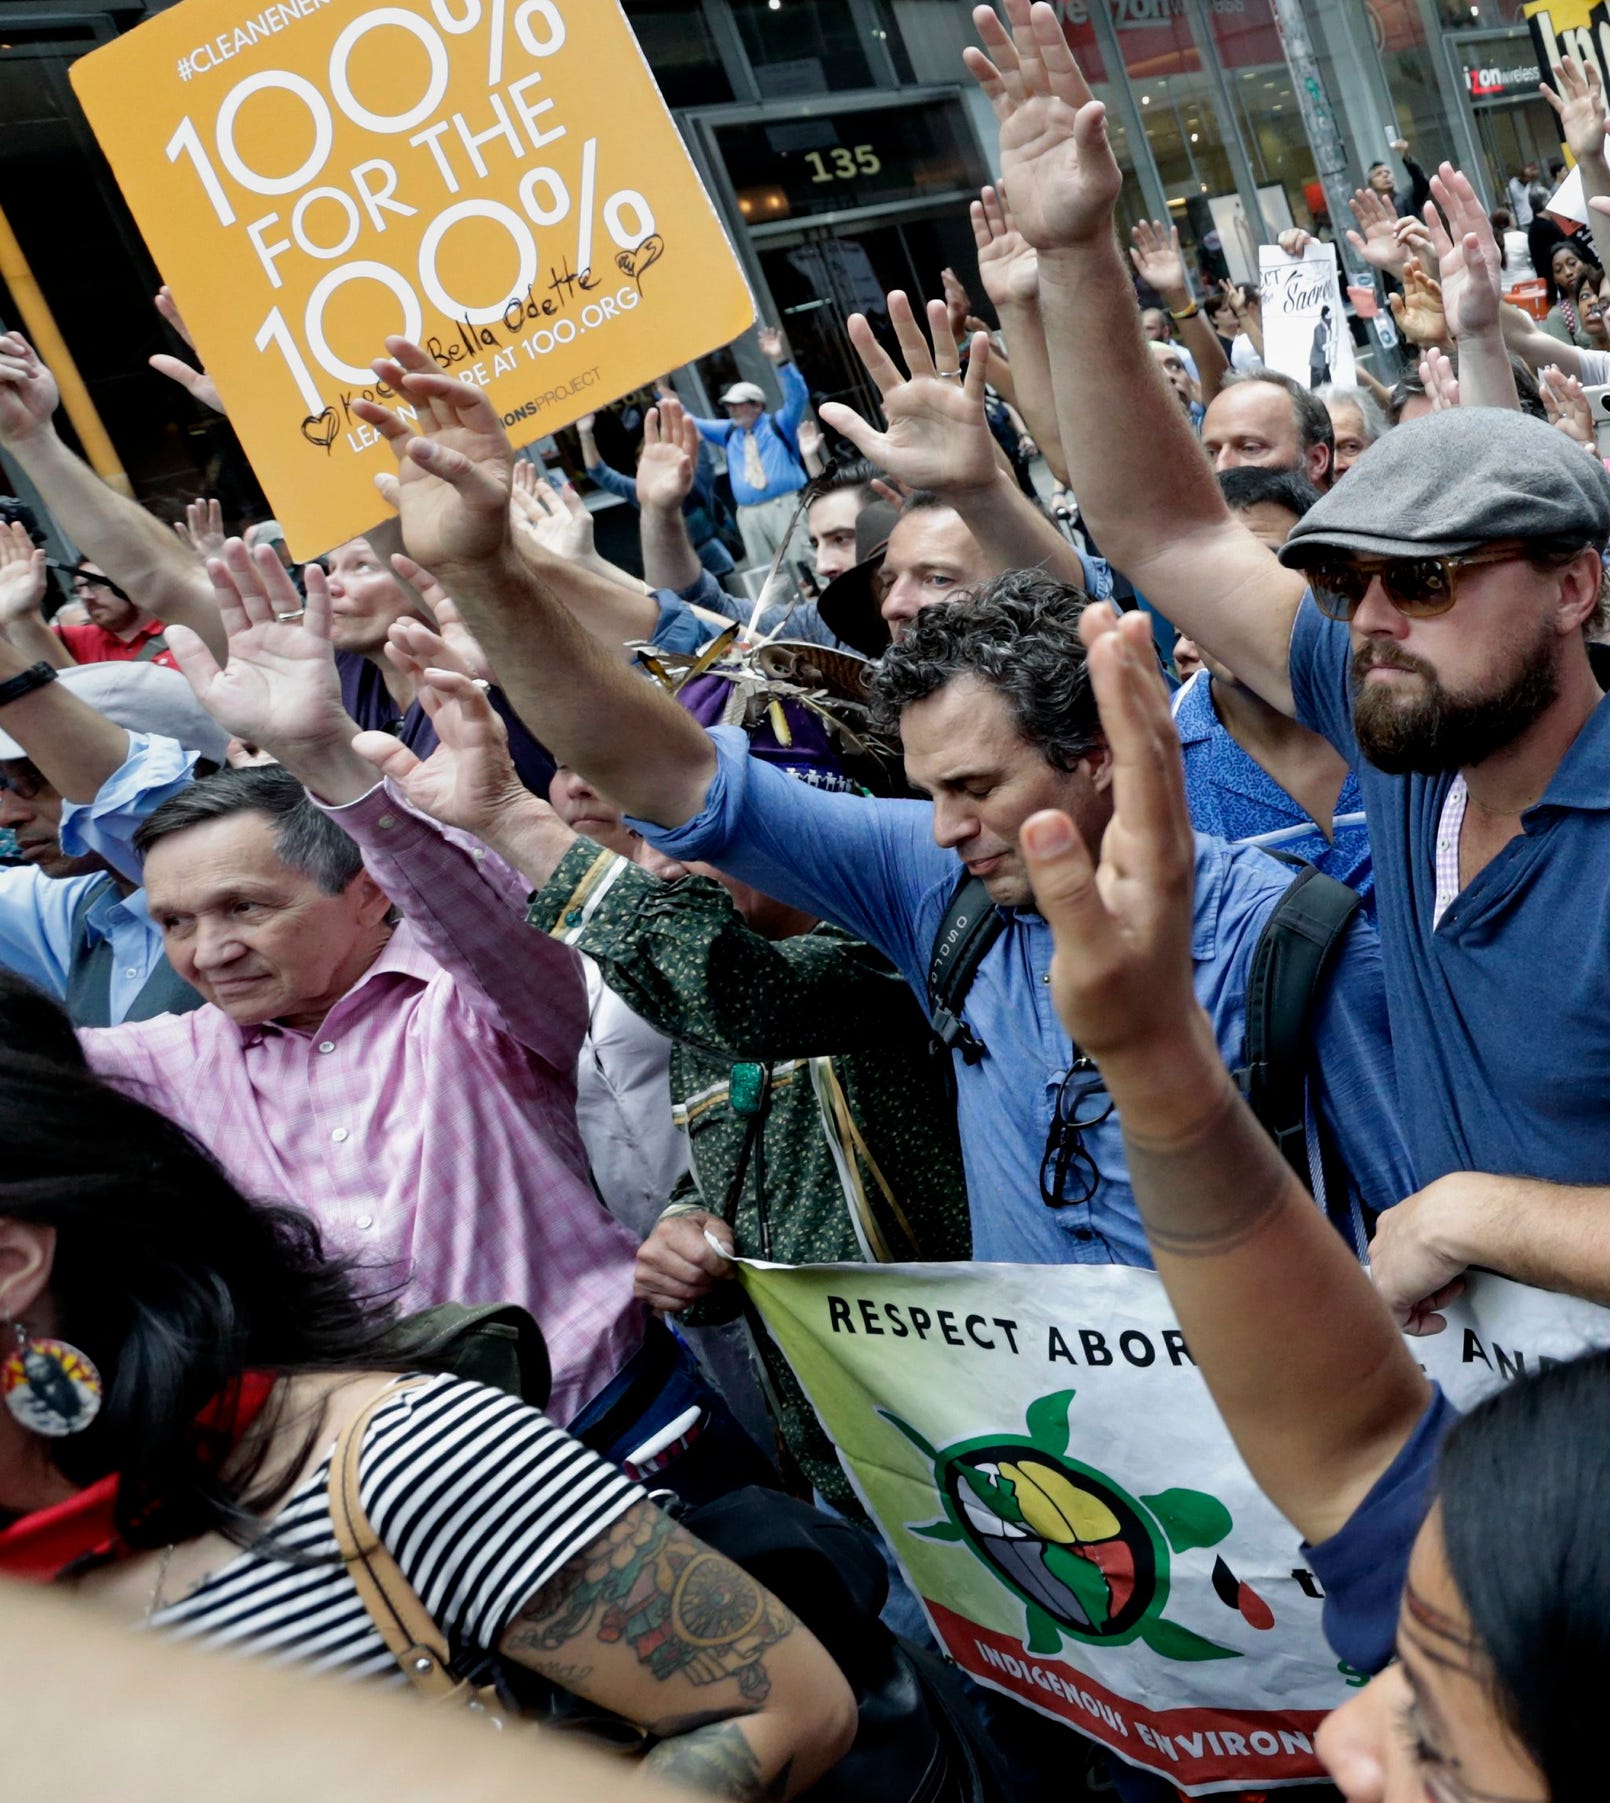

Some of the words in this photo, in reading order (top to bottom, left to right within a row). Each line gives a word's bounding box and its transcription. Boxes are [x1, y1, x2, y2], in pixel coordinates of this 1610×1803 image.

[247, 158, 419, 290] FOR
[408, 71, 567, 194] THE
[804, 144, 881, 183] 135
[254, 137, 656, 414] 100%
[346, 404, 418, 454] LEAN
[493, 346, 518, 379] AT
[522, 286, 640, 360] 100.ORG
[827, 1295, 1020, 1355] RESPECT
[974, 1639, 1129, 1738] INDIGENOUS
